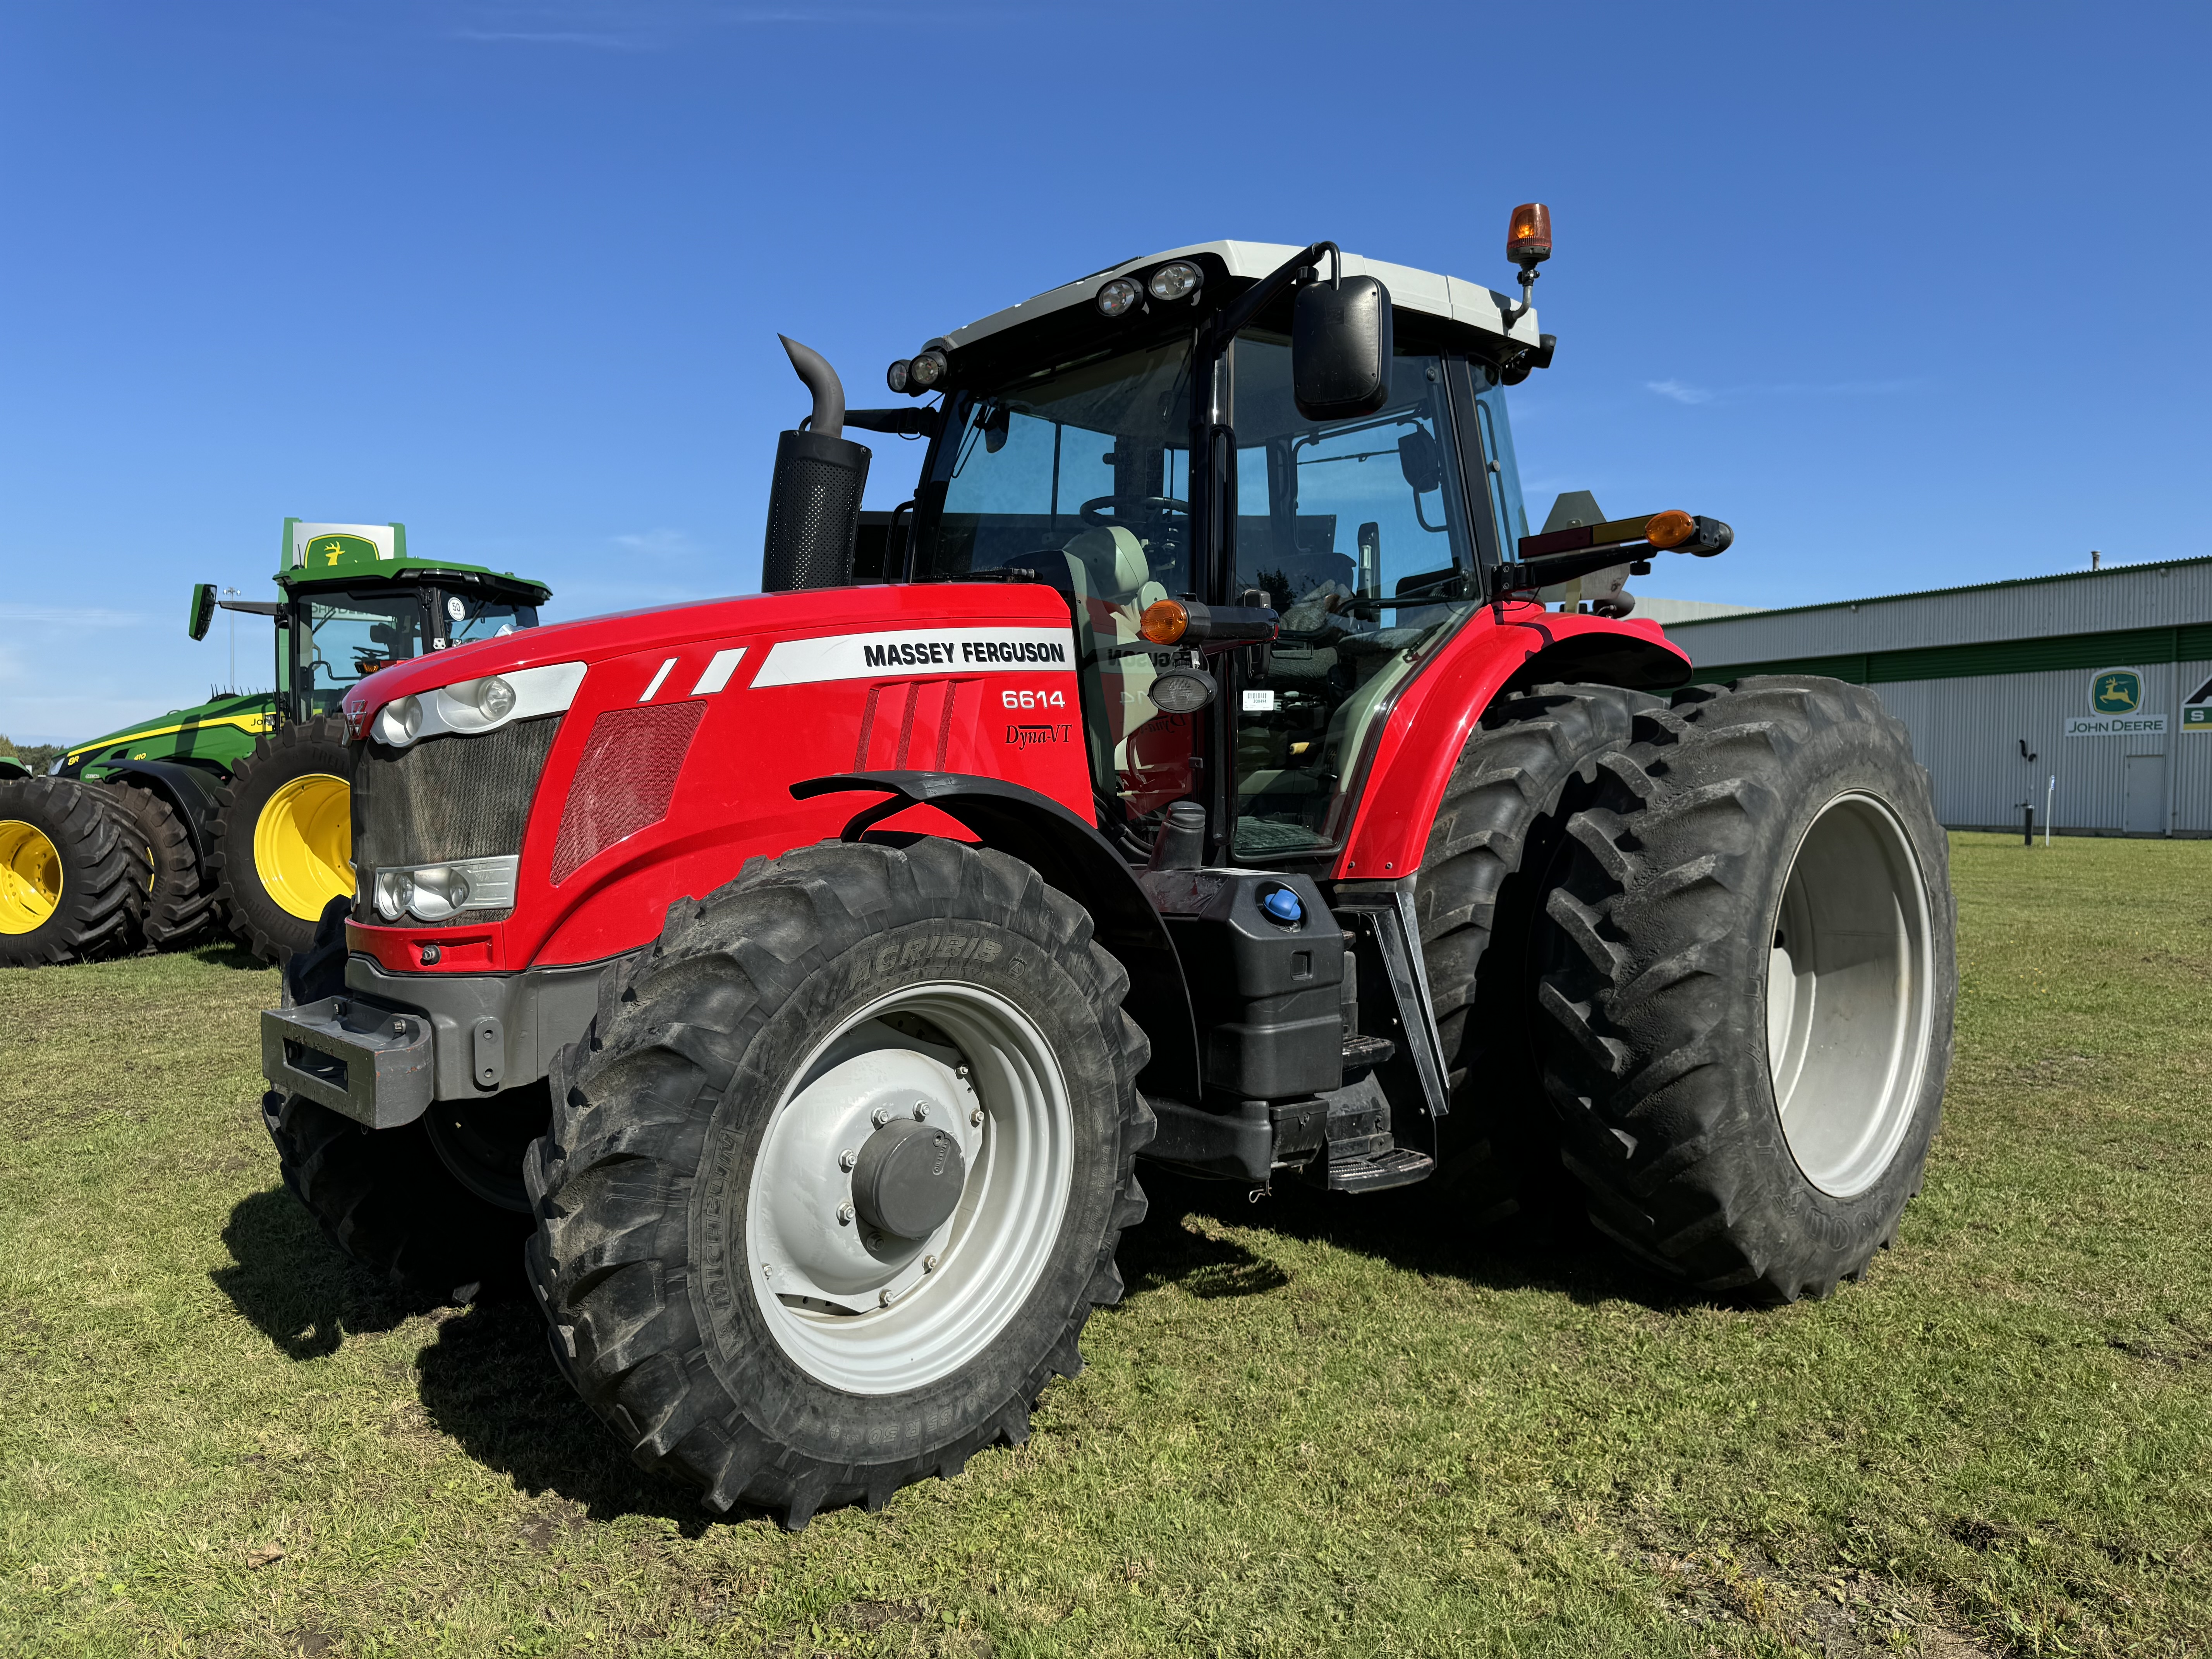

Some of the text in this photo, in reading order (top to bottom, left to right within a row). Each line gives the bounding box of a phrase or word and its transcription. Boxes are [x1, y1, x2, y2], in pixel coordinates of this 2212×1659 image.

[452, 602, 460, 611] 50
[864, 642, 1065, 667] MASSEY FERGUSON
[1002, 690, 1066, 709] 6614
[1005, 724, 1072, 750] Dyna-VT
[2069, 720, 2163, 733] JOHN DEERE
[68, 756, 80, 766] 8R
[134, 752, 147, 761] 410
[247, 899, 312, 943] RELLEBORG
[848, 935, 1003, 991] AGRIBIB
[1097, 1145, 1109, 1196] RADIAL
[706, 1133, 737, 1311] MICHELIN
[1073, 1205, 1101, 1274] TUBELESS
[867, 1425, 898, 1445] 30
[905, 1420, 921, 1438] R
